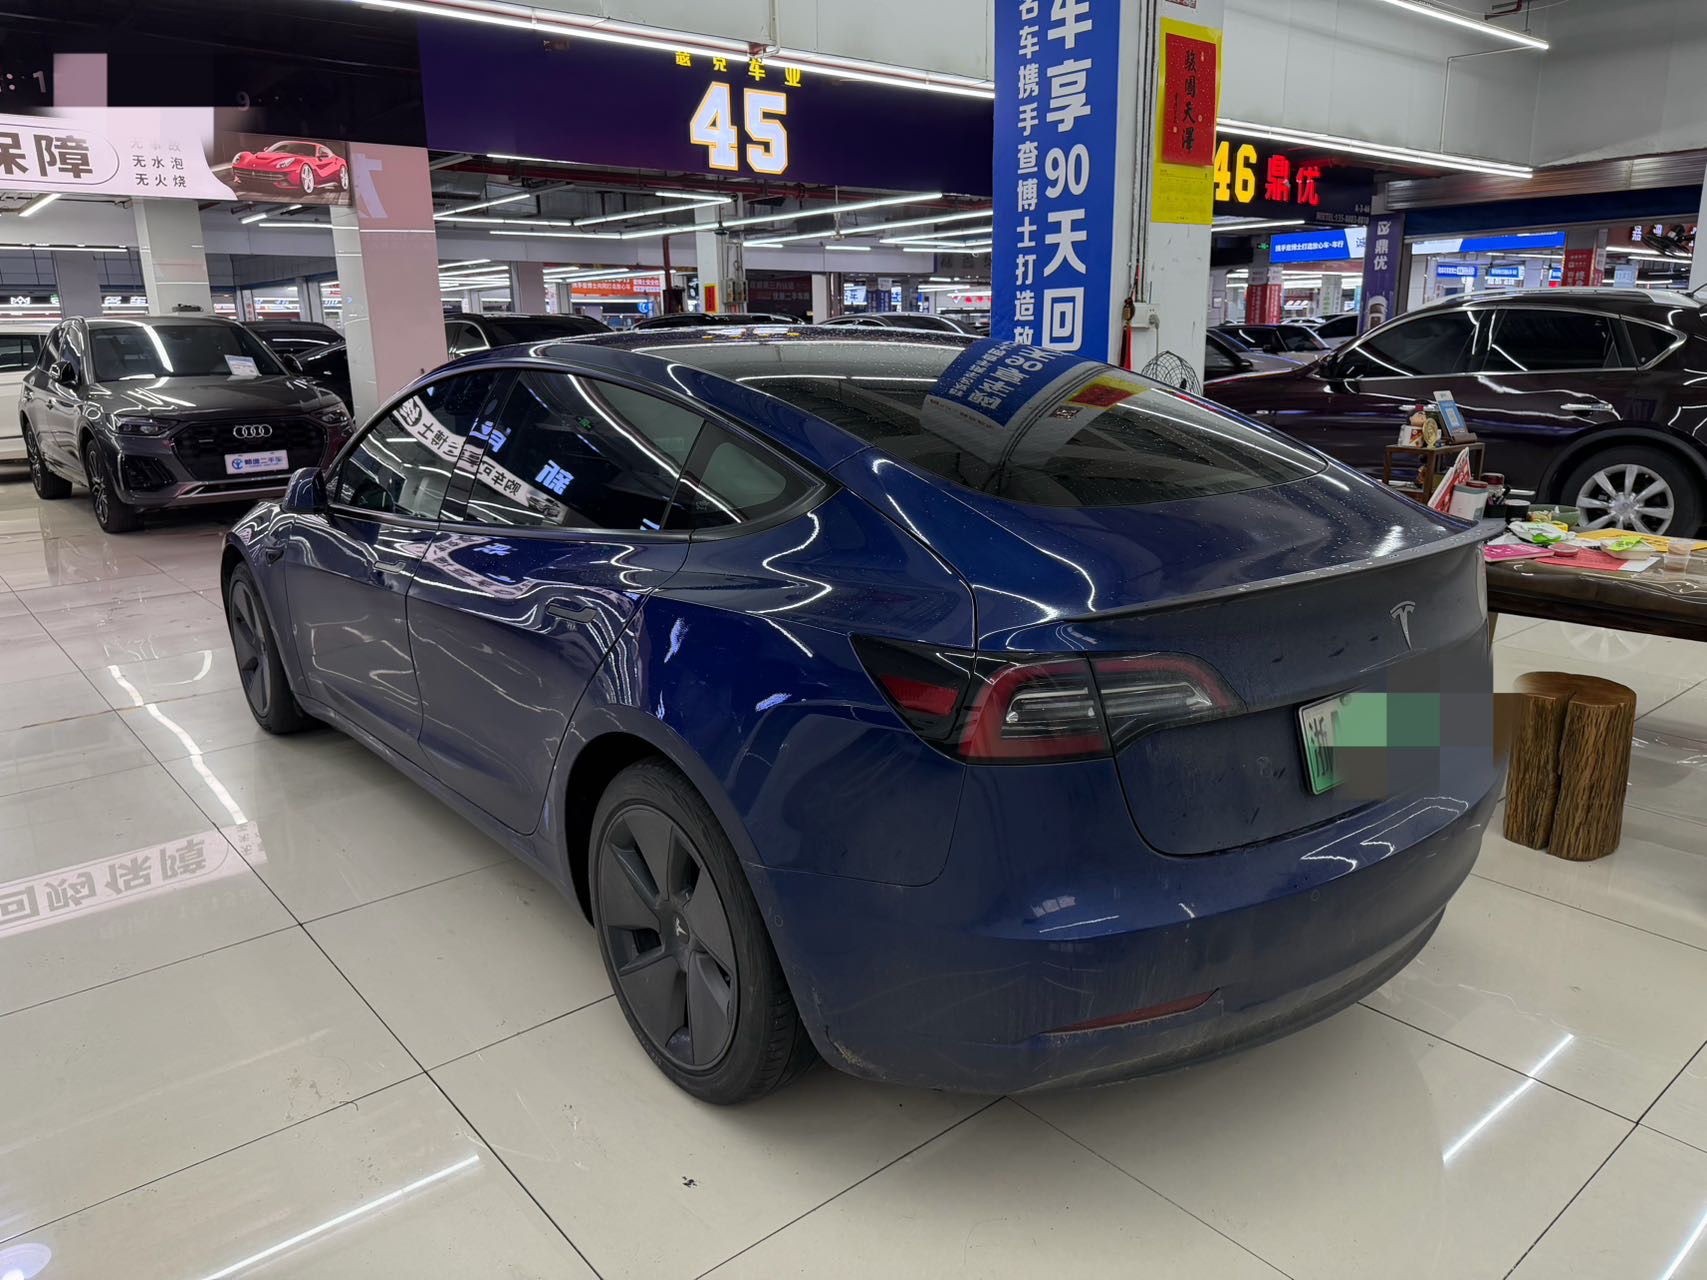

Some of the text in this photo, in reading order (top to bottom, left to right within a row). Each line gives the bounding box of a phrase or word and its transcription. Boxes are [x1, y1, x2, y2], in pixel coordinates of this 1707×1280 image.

[689, 81, 788, 175] 45
[132, 154, 184, 170] 无水泡
[135, 173, 188, 188] 无火烧
[1213, 141, 1257, 203] 46
[1264, 154, 1321, 206] 鼎优
